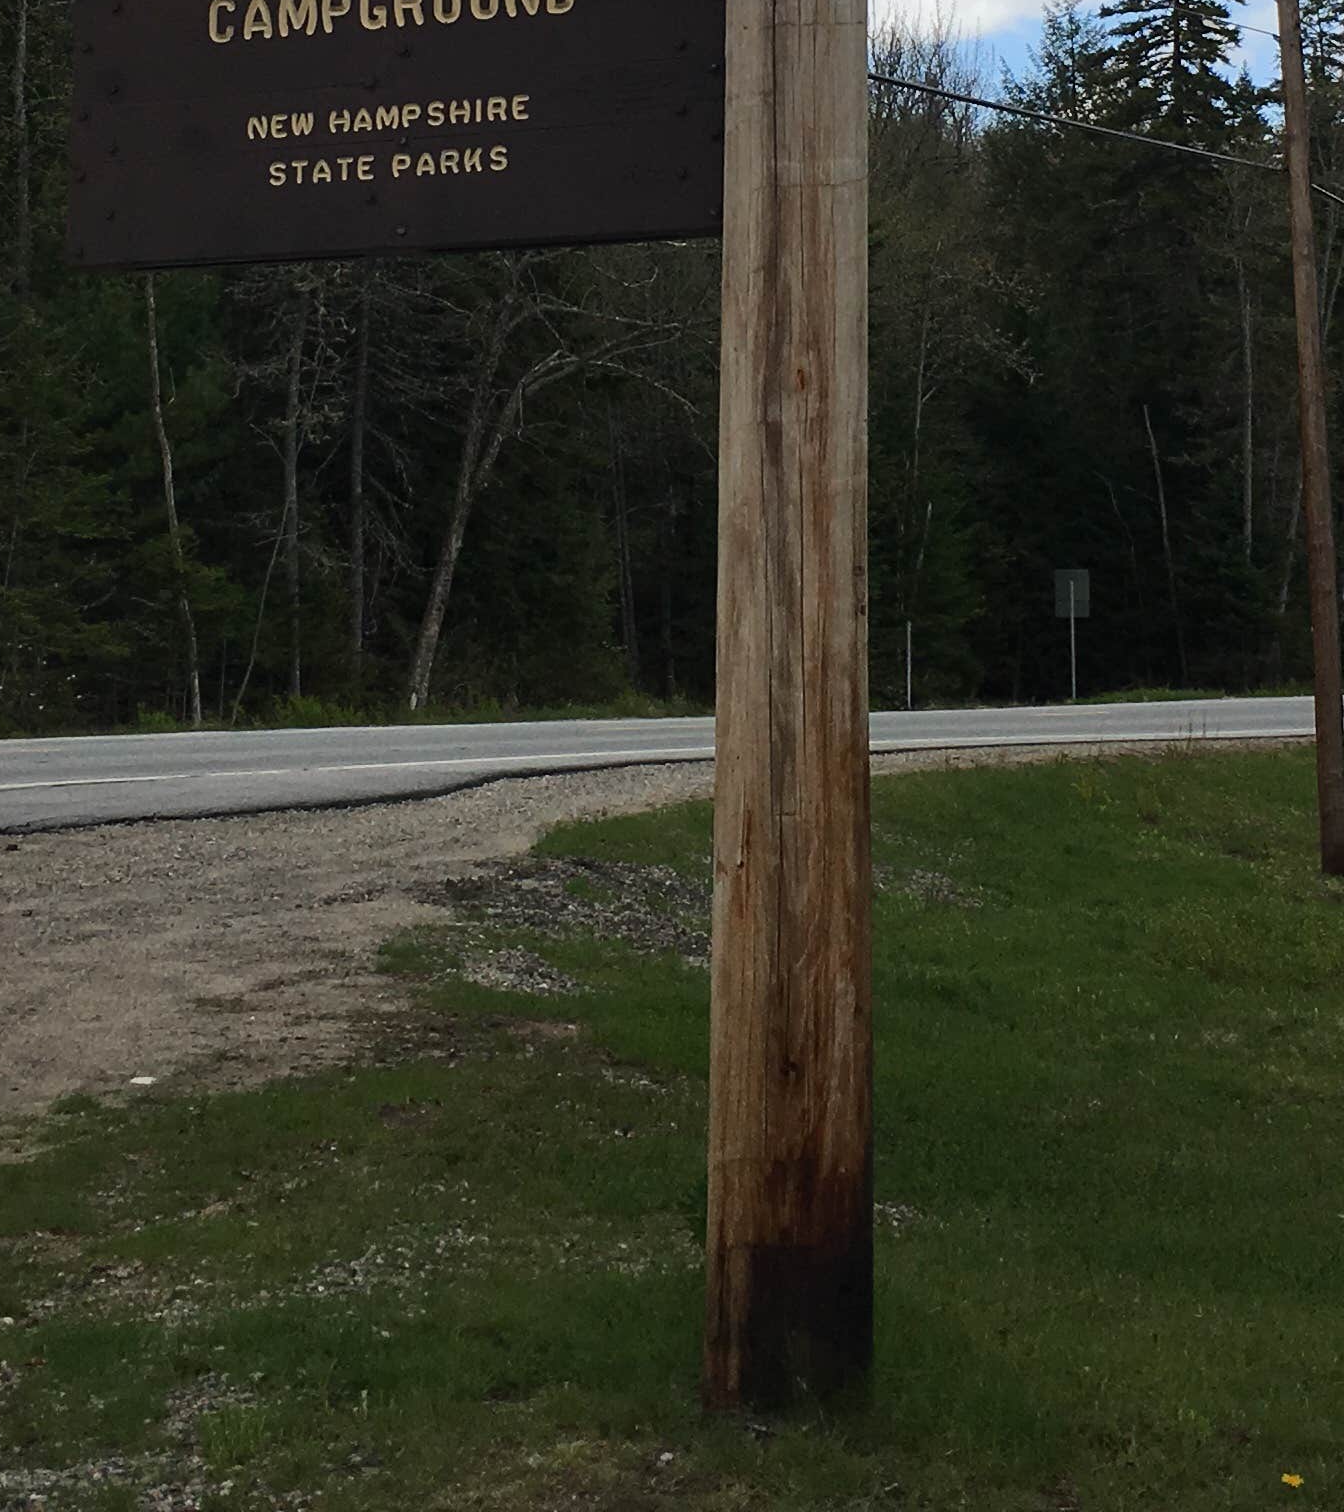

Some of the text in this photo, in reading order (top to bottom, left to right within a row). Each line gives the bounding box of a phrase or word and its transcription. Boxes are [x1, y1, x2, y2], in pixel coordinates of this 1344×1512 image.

[247, 94, 531, 140] NEW HAMPSHIRE
[269, 145, 508, 186] STATE PARKS
